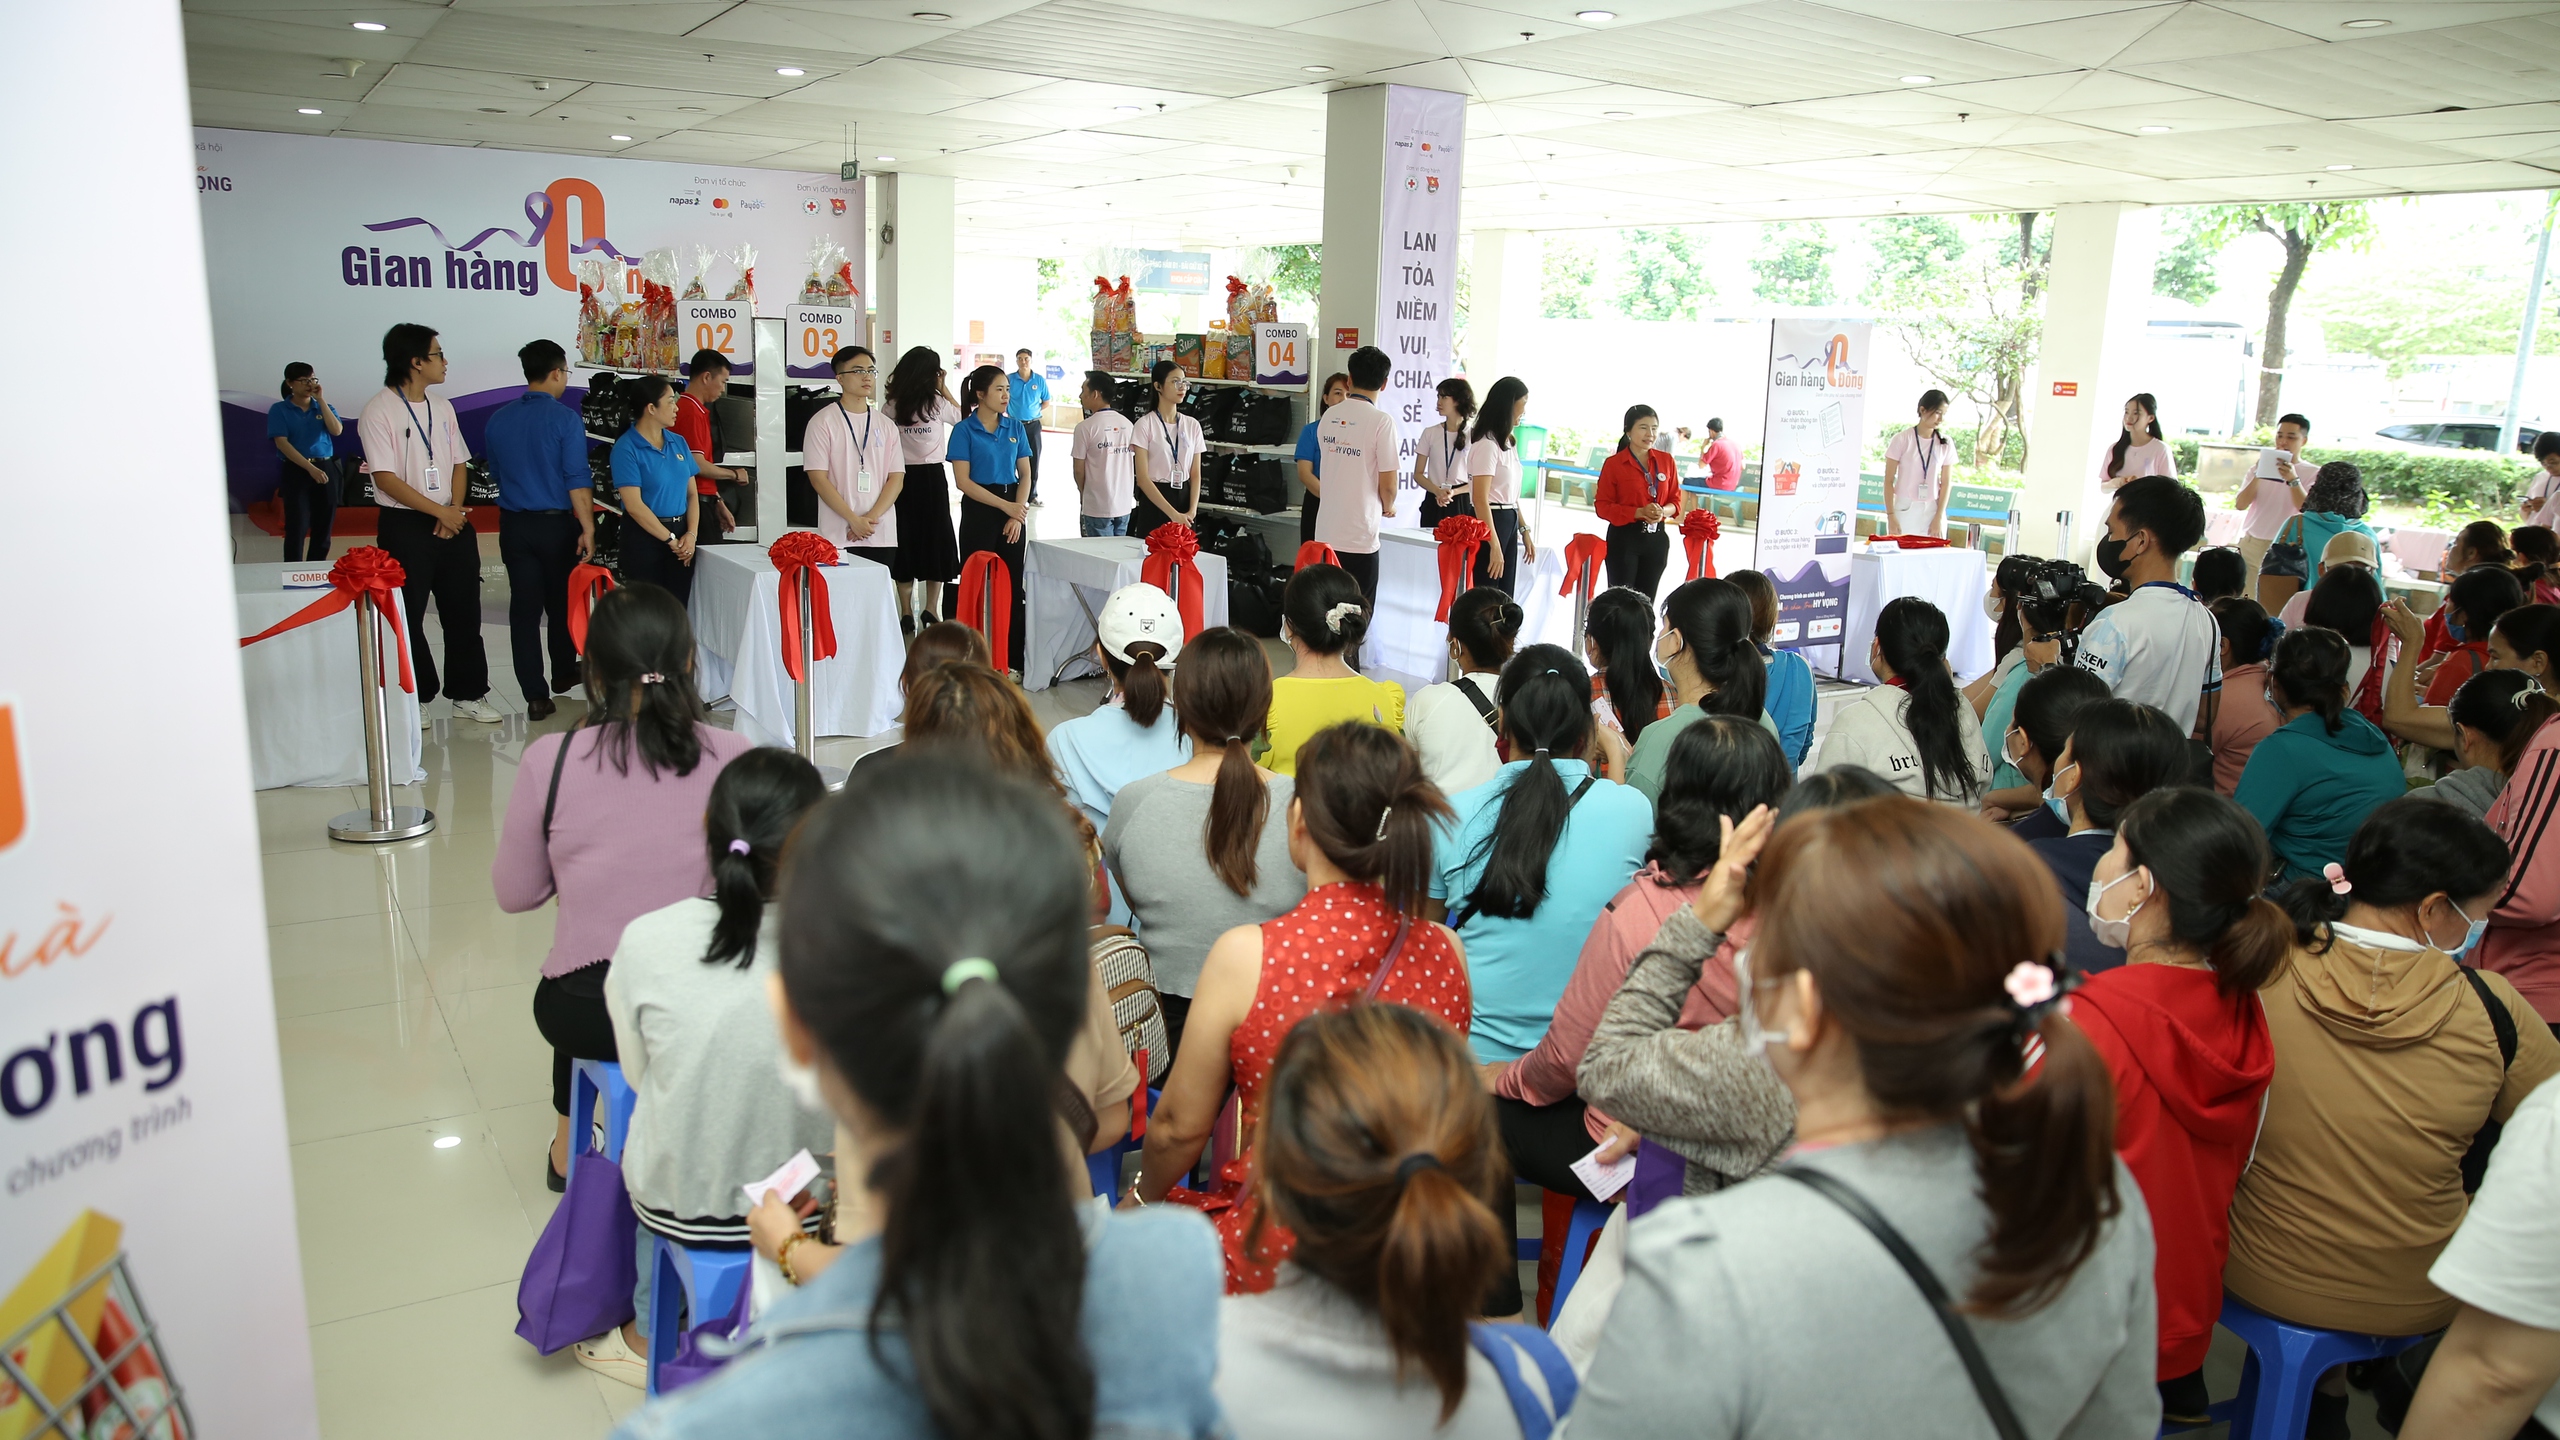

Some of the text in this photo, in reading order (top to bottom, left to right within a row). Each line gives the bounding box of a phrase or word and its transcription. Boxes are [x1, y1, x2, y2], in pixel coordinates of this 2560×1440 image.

[1403, 230, 1436, 252] LAN
[341, 245, 432, 288] Gian
[445, 250, 539, 296] hàng
[1402, 261, 1435, 286] TỎA
[690, 307, 737, 319] COMBO
[799, 312, 843, 325] COMBO
[1396, 296, 1437, 321] NIỀM
[695, 323, 735, 354] 02
[803, 327, 839, 358] 03
[1265, 329, 1298, 339] COMBO
[1268, 341, 1296, 367] 04
[1400, 335, 1430, 358] VUI,
[1394, 370, 1433, 389] CHIA
[1775, 371, 1798, 386] Gian
[1801, 371, 1825, 391] hàng
[1838, 371, 1864, 390] Đồng
[1402, 398, 1423, 423] SẺ
[904, 427, 931, 436] HY VỌNG
[292, 572, 329, 582] COMBO
